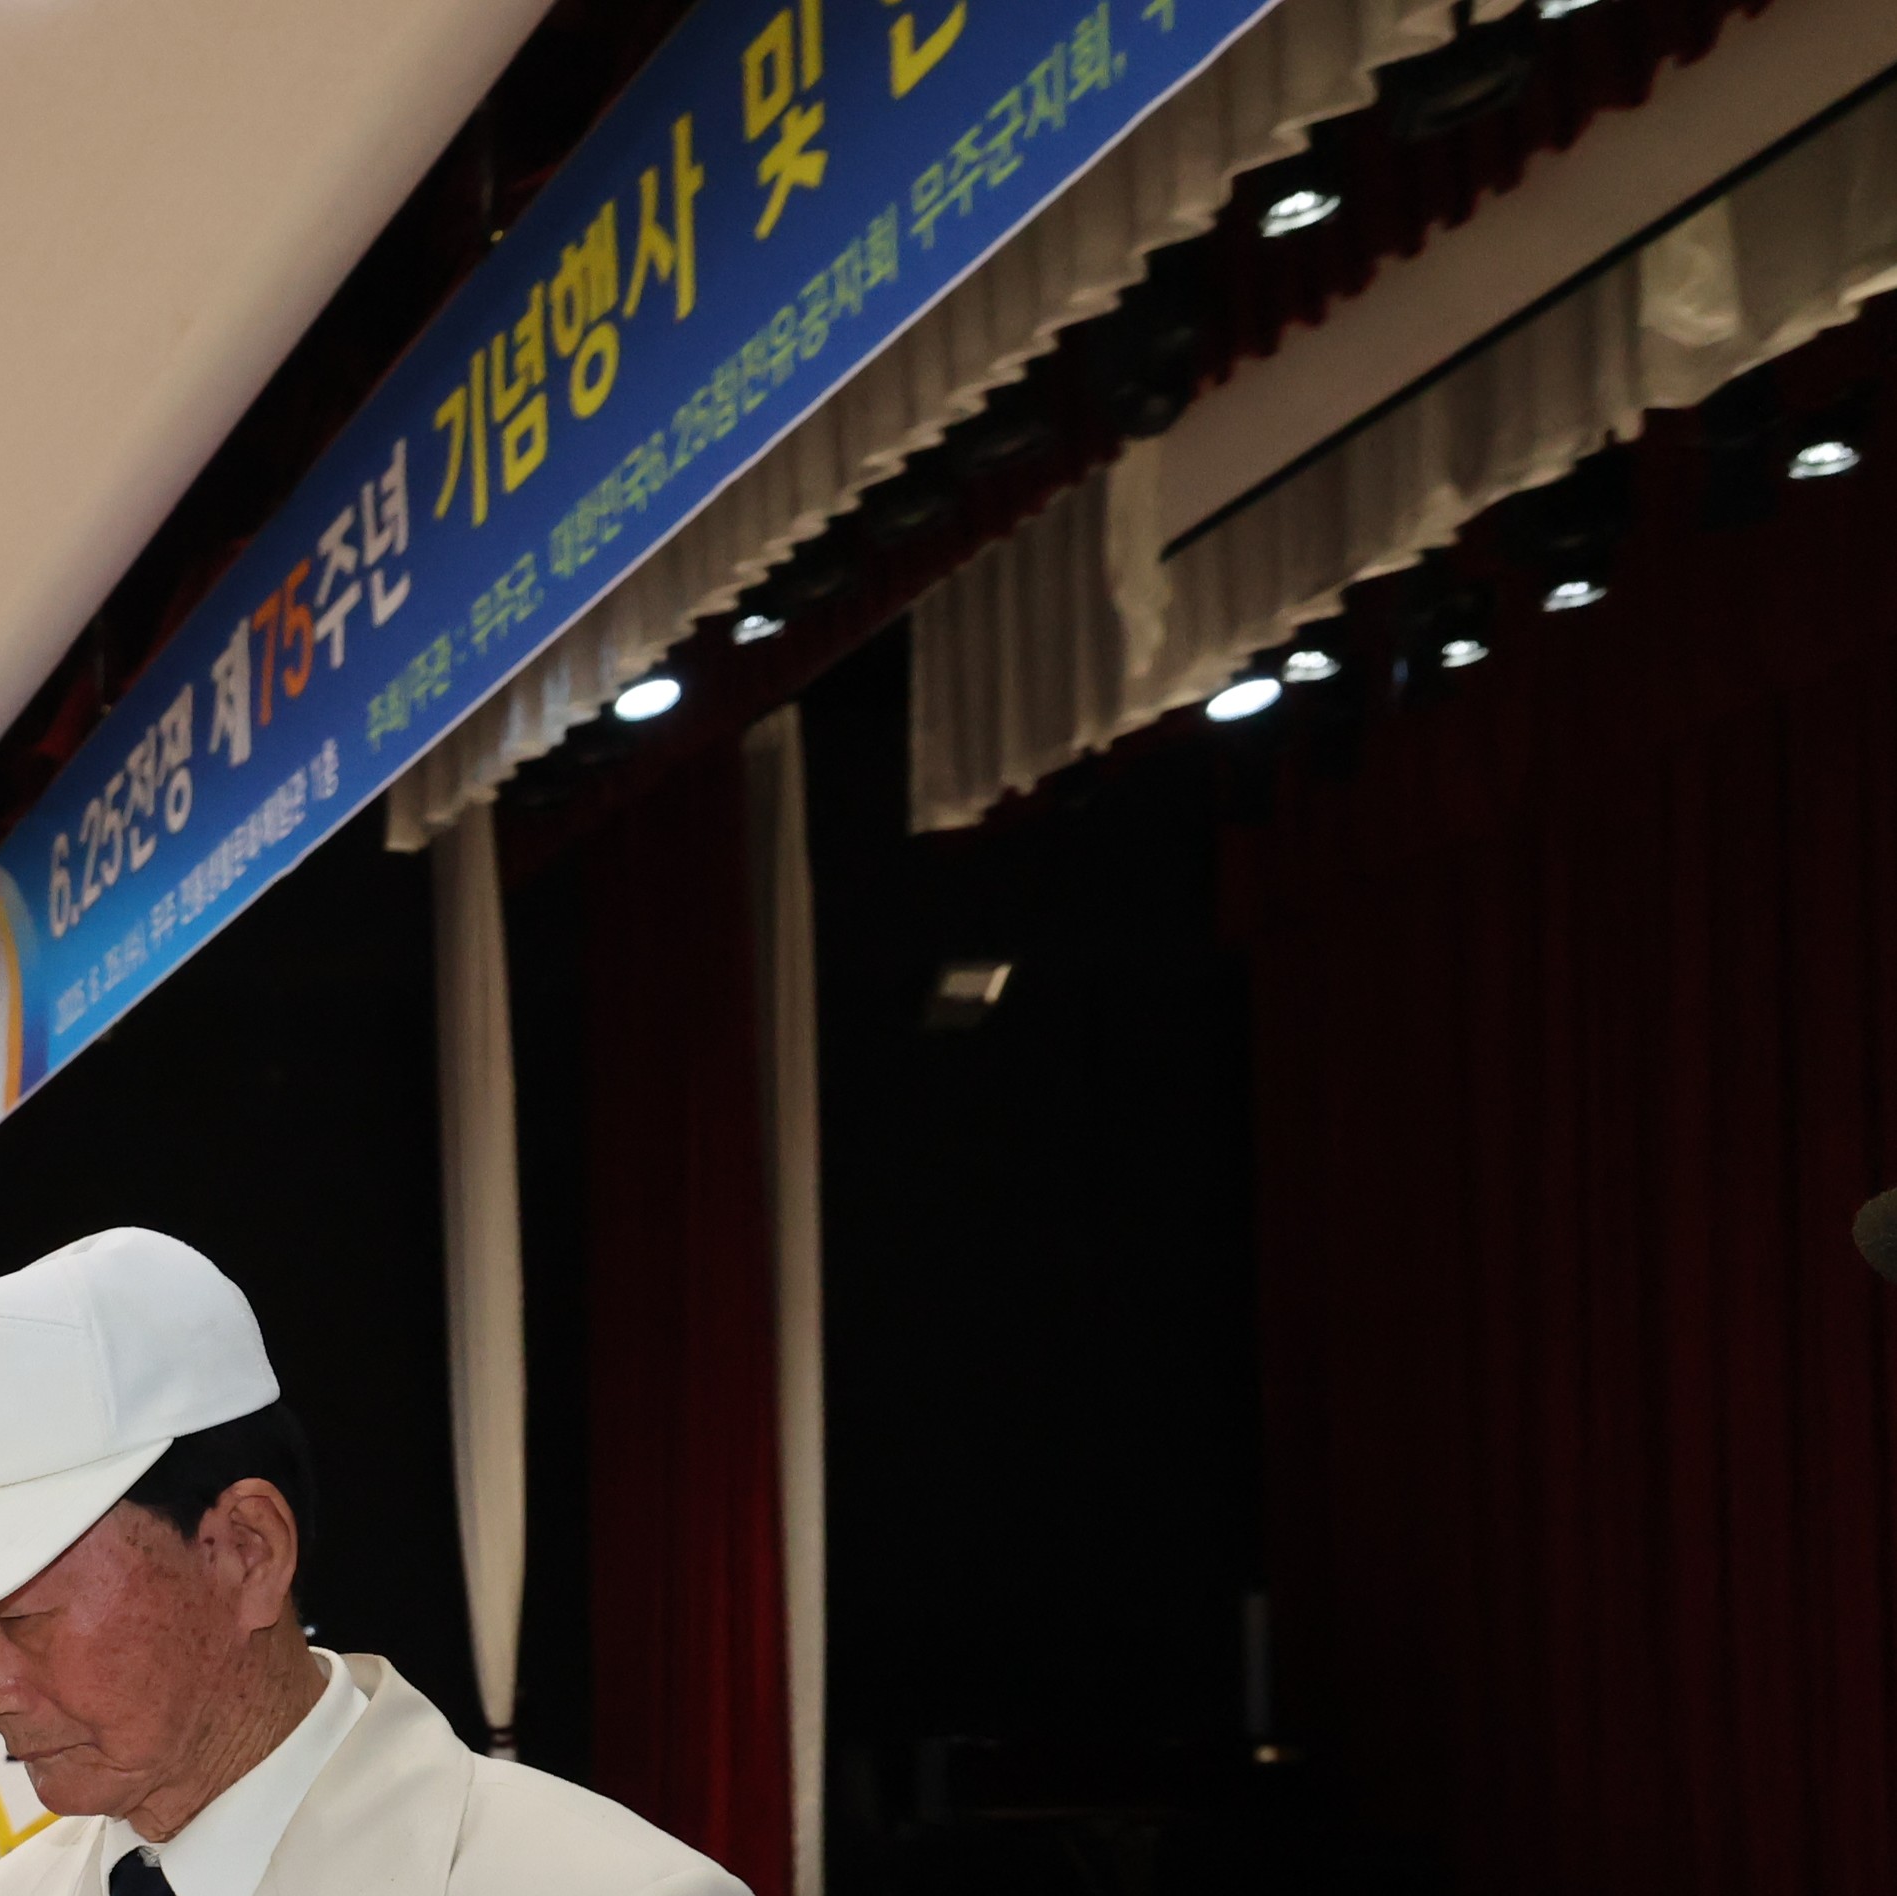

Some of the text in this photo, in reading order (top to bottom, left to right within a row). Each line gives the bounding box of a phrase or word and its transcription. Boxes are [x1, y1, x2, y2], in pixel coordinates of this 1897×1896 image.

[48, 684, 194, 938] 6.25전쟁
[209, 438, 411, 766] 제75주년
[433, 113, 704, 527] 기념행사
[742, 0, 829, 240] 및
